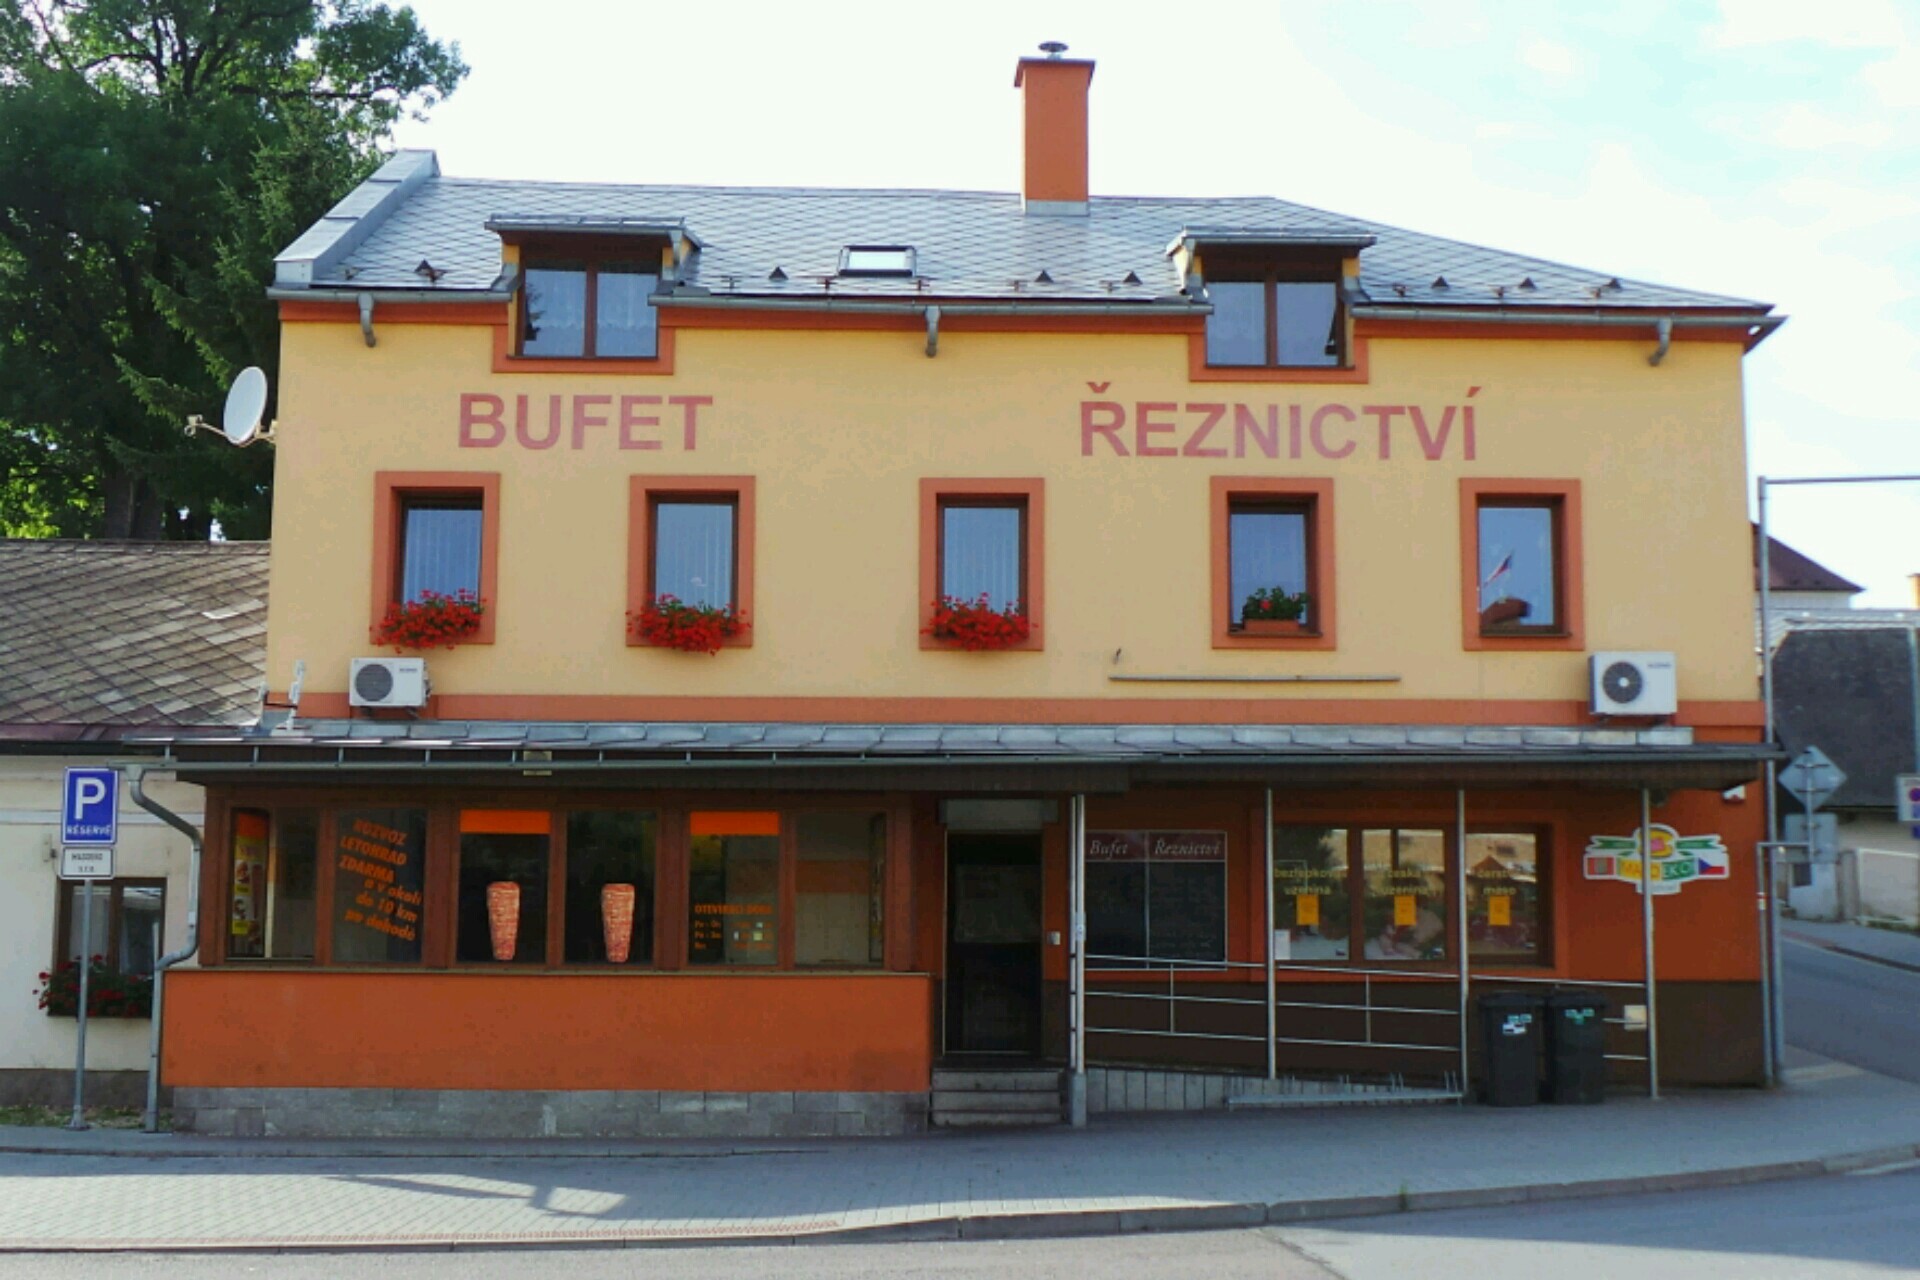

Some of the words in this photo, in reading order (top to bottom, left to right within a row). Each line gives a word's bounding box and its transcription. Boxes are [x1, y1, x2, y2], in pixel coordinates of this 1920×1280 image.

[459, 393, 714, 450] BUFET
[1080, 381, 1483, 461] ŘEZNICTVÍ
[74, 777, 106, 820] P
[1089, 839, 1129, 860] Bufet
[338, 854, 396, 884] ZDARMA
[355, 890, 374, 907] do
[378, 898, 395, 913] 10
[396, 903, 418, 923] km
